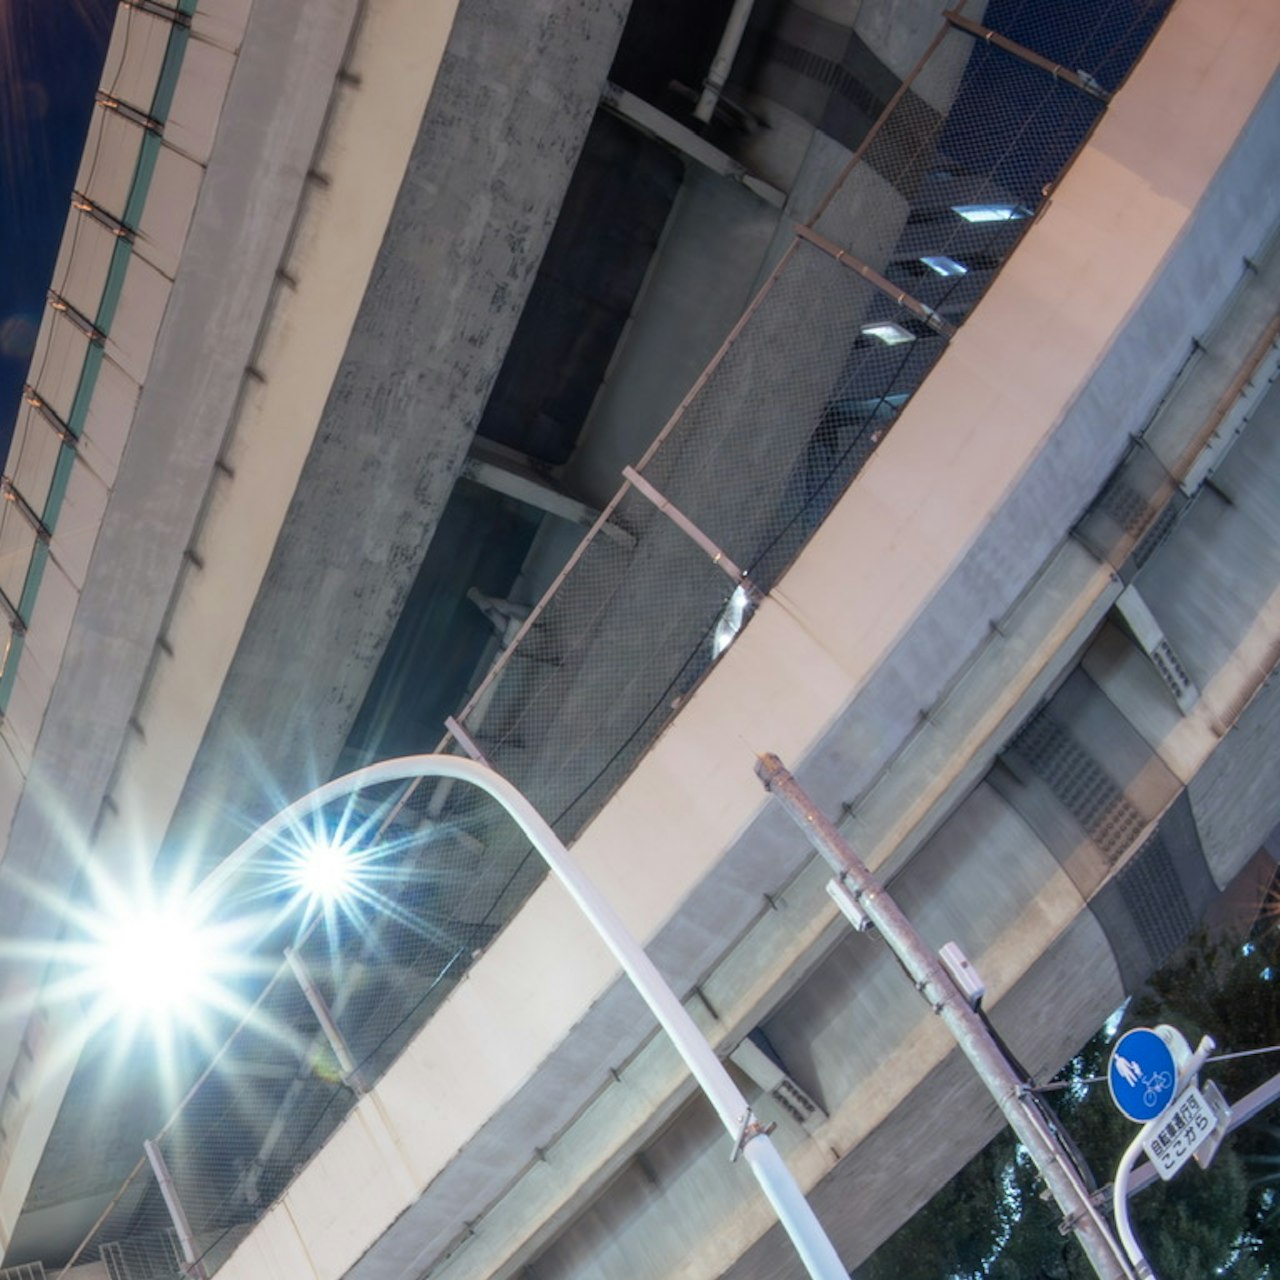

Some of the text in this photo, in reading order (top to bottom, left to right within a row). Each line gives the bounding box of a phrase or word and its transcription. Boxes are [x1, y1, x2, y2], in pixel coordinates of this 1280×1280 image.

[1151, 1093, 1200, 1159] 自転車通行可
[1161, 1112, 1209, 1170] ここから
